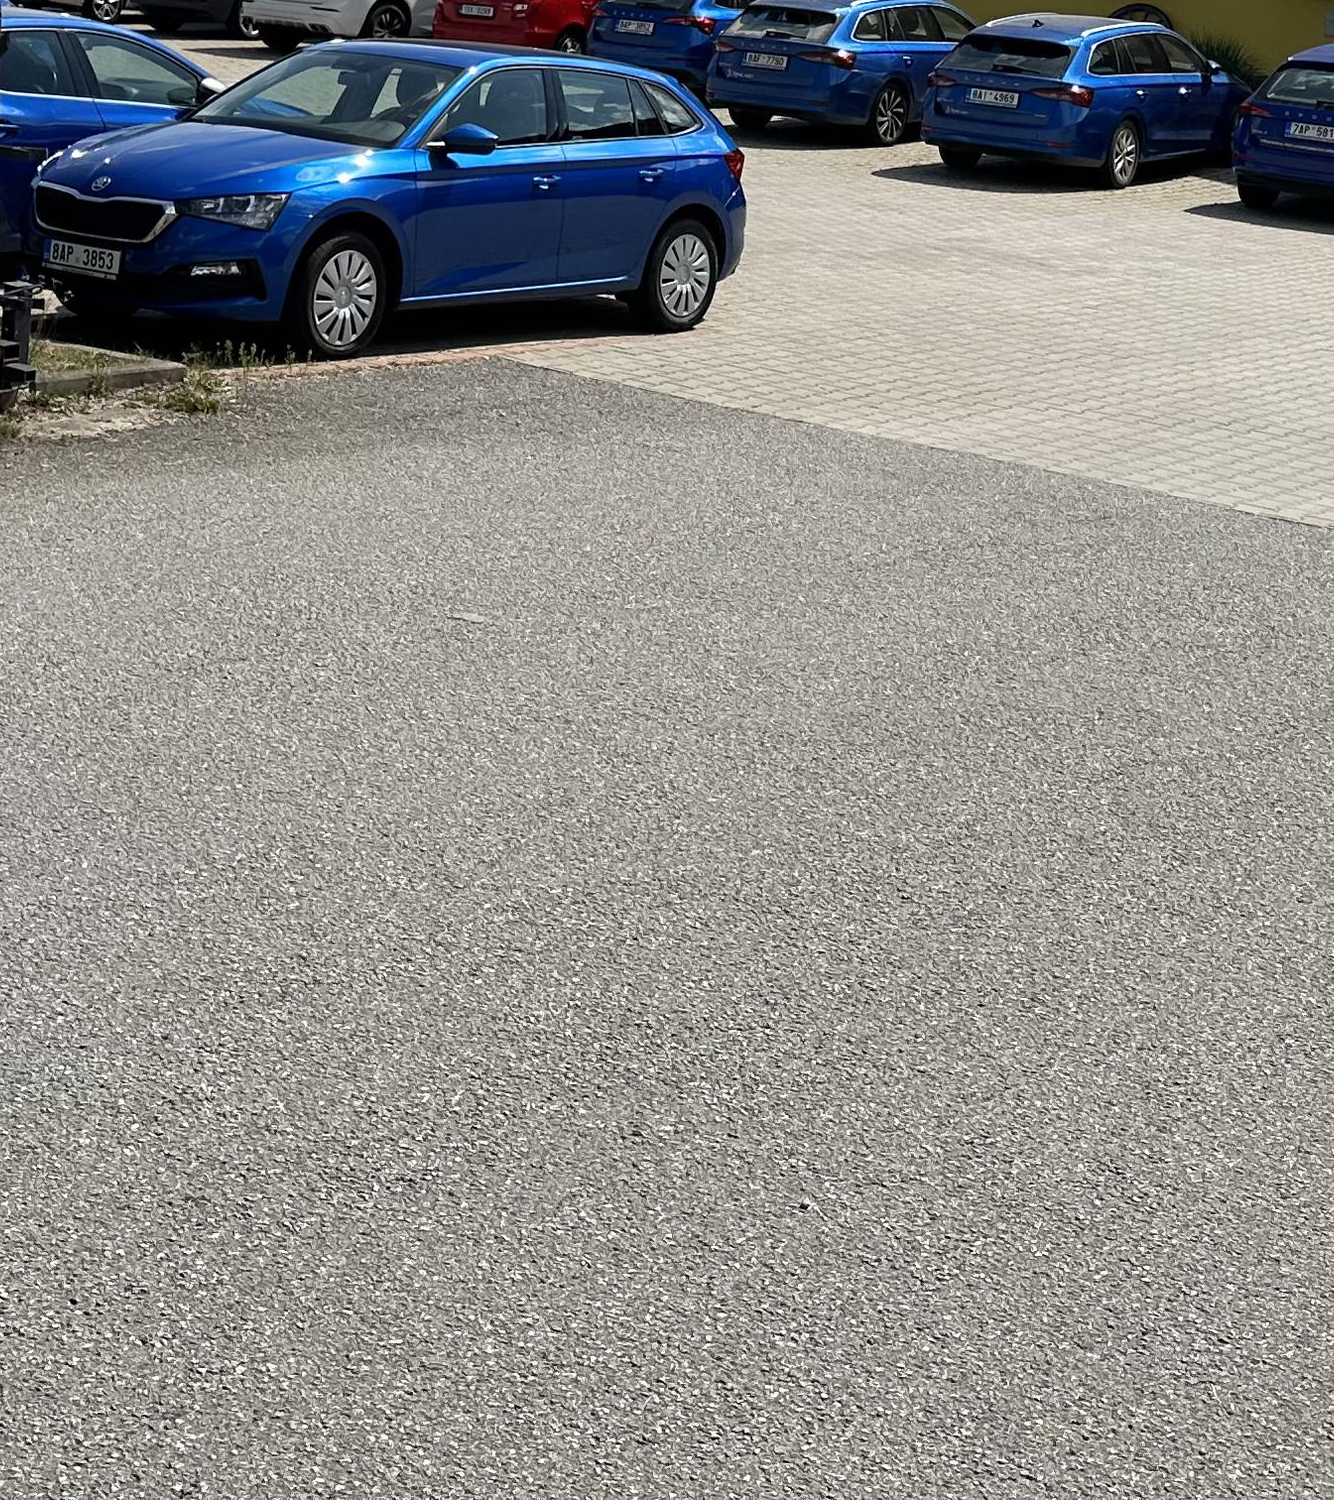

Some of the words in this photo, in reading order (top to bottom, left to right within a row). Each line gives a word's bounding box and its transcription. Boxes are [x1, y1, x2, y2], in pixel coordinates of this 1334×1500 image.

[1292, 123, 1311, 135] 7AP
[51, 242, 74, 263] 8AP
[82, 248, 114, 270] 3853
